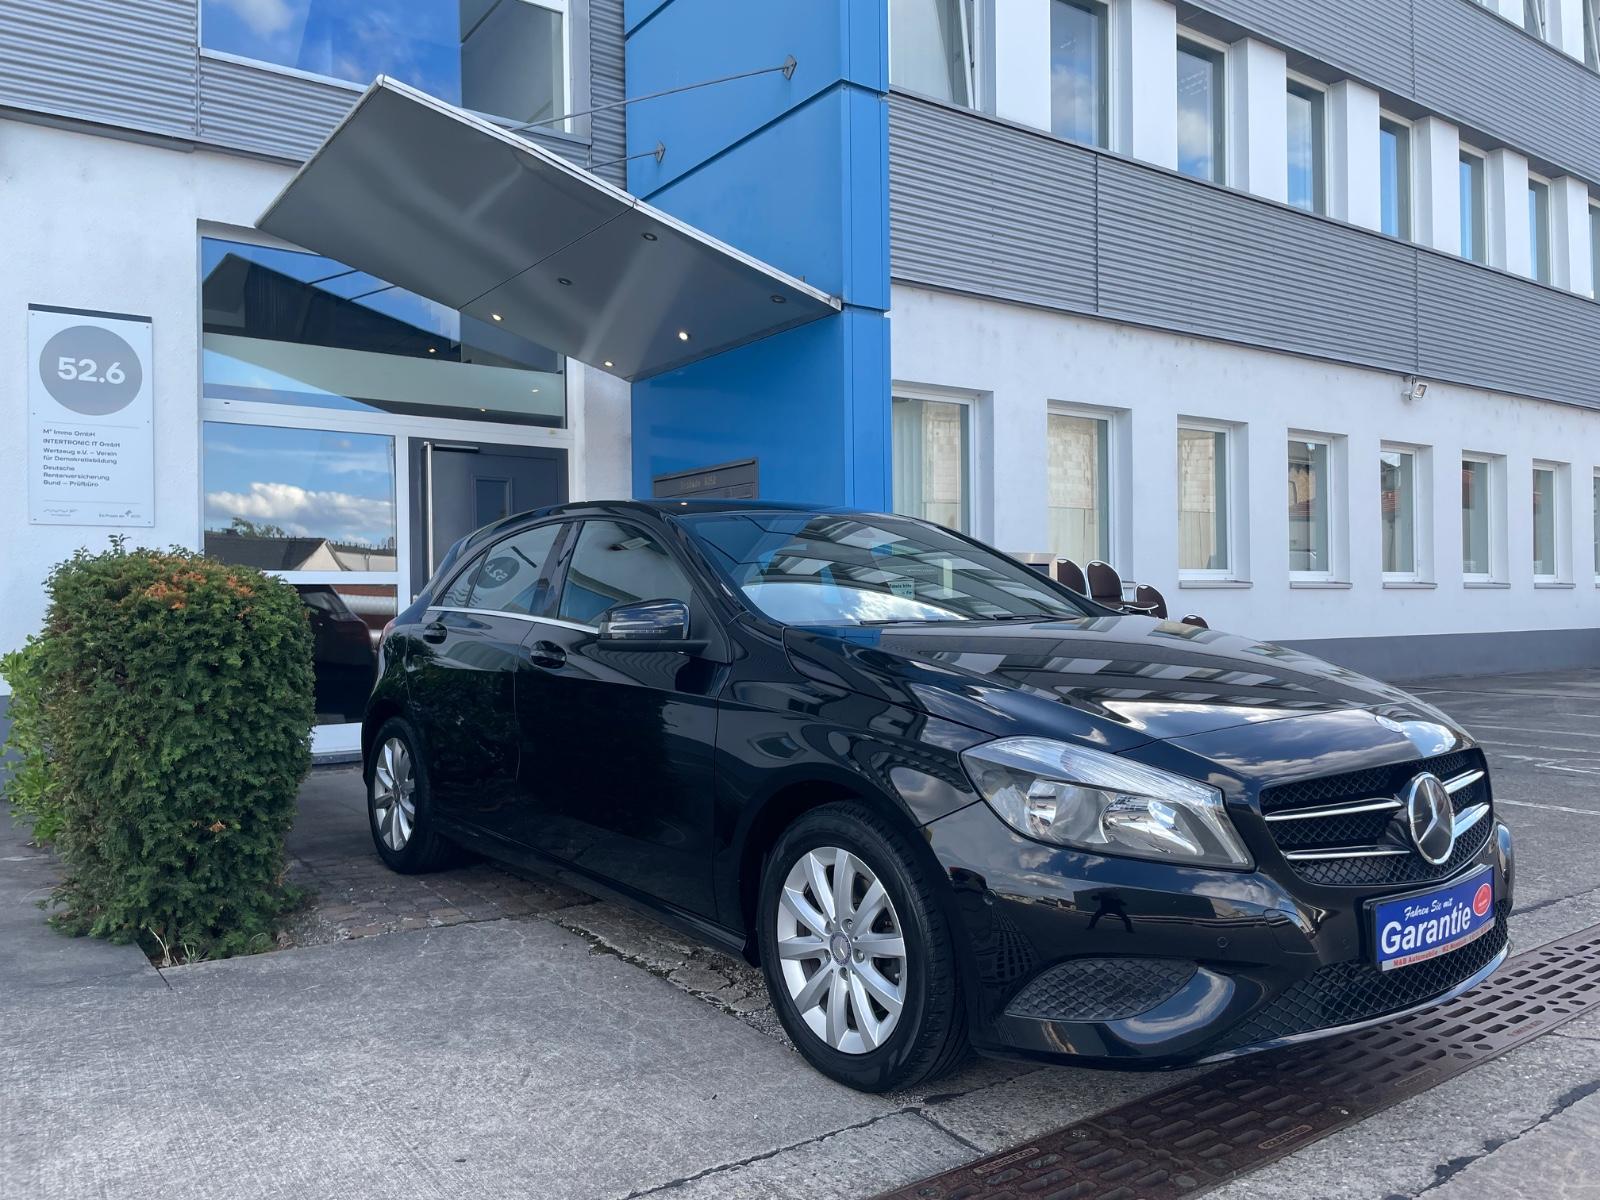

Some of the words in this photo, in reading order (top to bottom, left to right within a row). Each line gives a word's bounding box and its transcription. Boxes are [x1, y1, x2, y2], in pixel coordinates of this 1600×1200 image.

[57, 356, 126, 385] 52.6
[43, 438, 90, 446] INTERTRONIC
[43, 447, 75, 455] Wertzeug
[54, 455, 117, 465] Demokratiebildung
[43, 472, 110, 481] Rentenversicherung
[69, 480, 99, 488] Prüfbüro
[1404, 906, 1429, 922] Fahren
[1431, 899, 1442, 913] Sie
[1443, 898, 1454, 908] mit
[1381, 902, 1471, 955] Garantie
